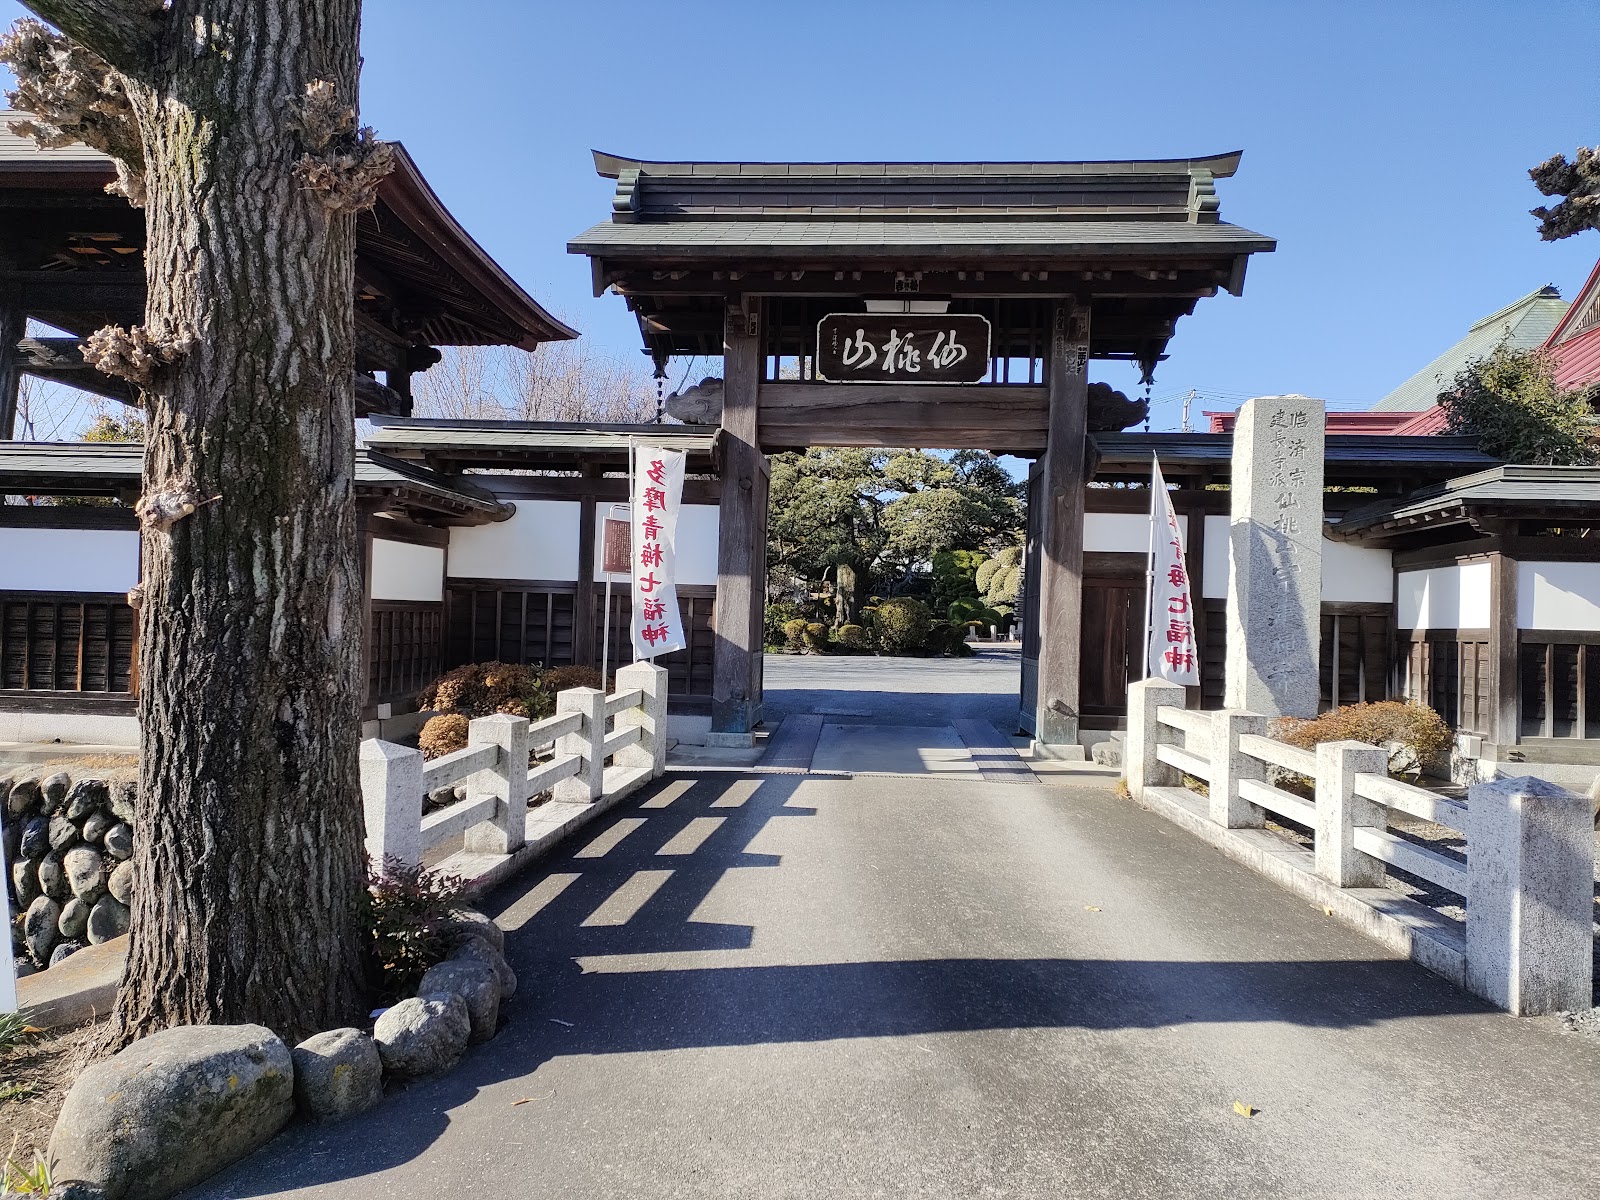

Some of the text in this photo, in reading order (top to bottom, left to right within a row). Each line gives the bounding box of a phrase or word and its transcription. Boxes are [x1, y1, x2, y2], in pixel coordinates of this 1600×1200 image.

[1270, 409, 1289, 488] 建長寺派
[1289, 411, 1309, 488] 臨済宗
